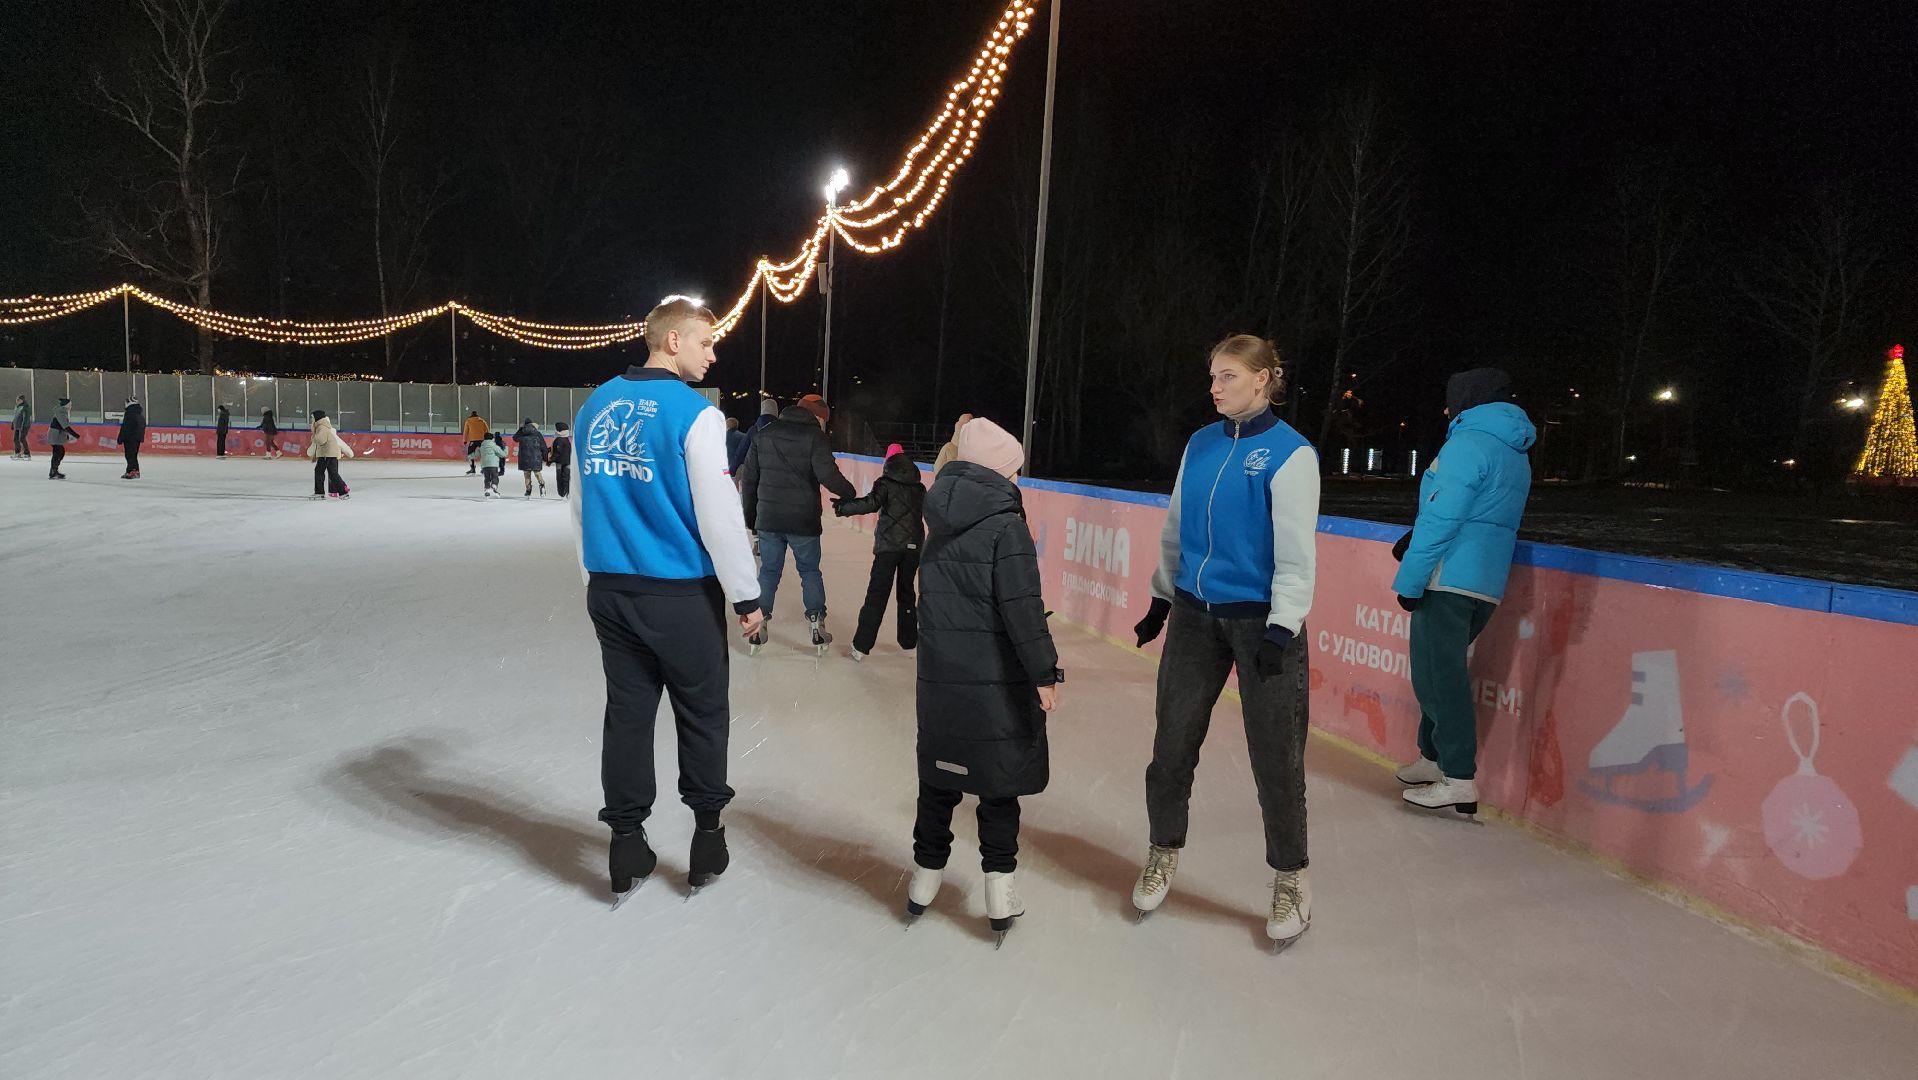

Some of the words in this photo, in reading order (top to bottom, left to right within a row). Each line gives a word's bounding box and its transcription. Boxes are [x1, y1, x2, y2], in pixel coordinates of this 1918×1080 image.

[152, 432, 196, 445] ЗИМА
[391, 438, 433, 449] ЗИМА
[1063, 517, 1130, 578] ЗИМА
[1318, 630, 1330, 652] С
